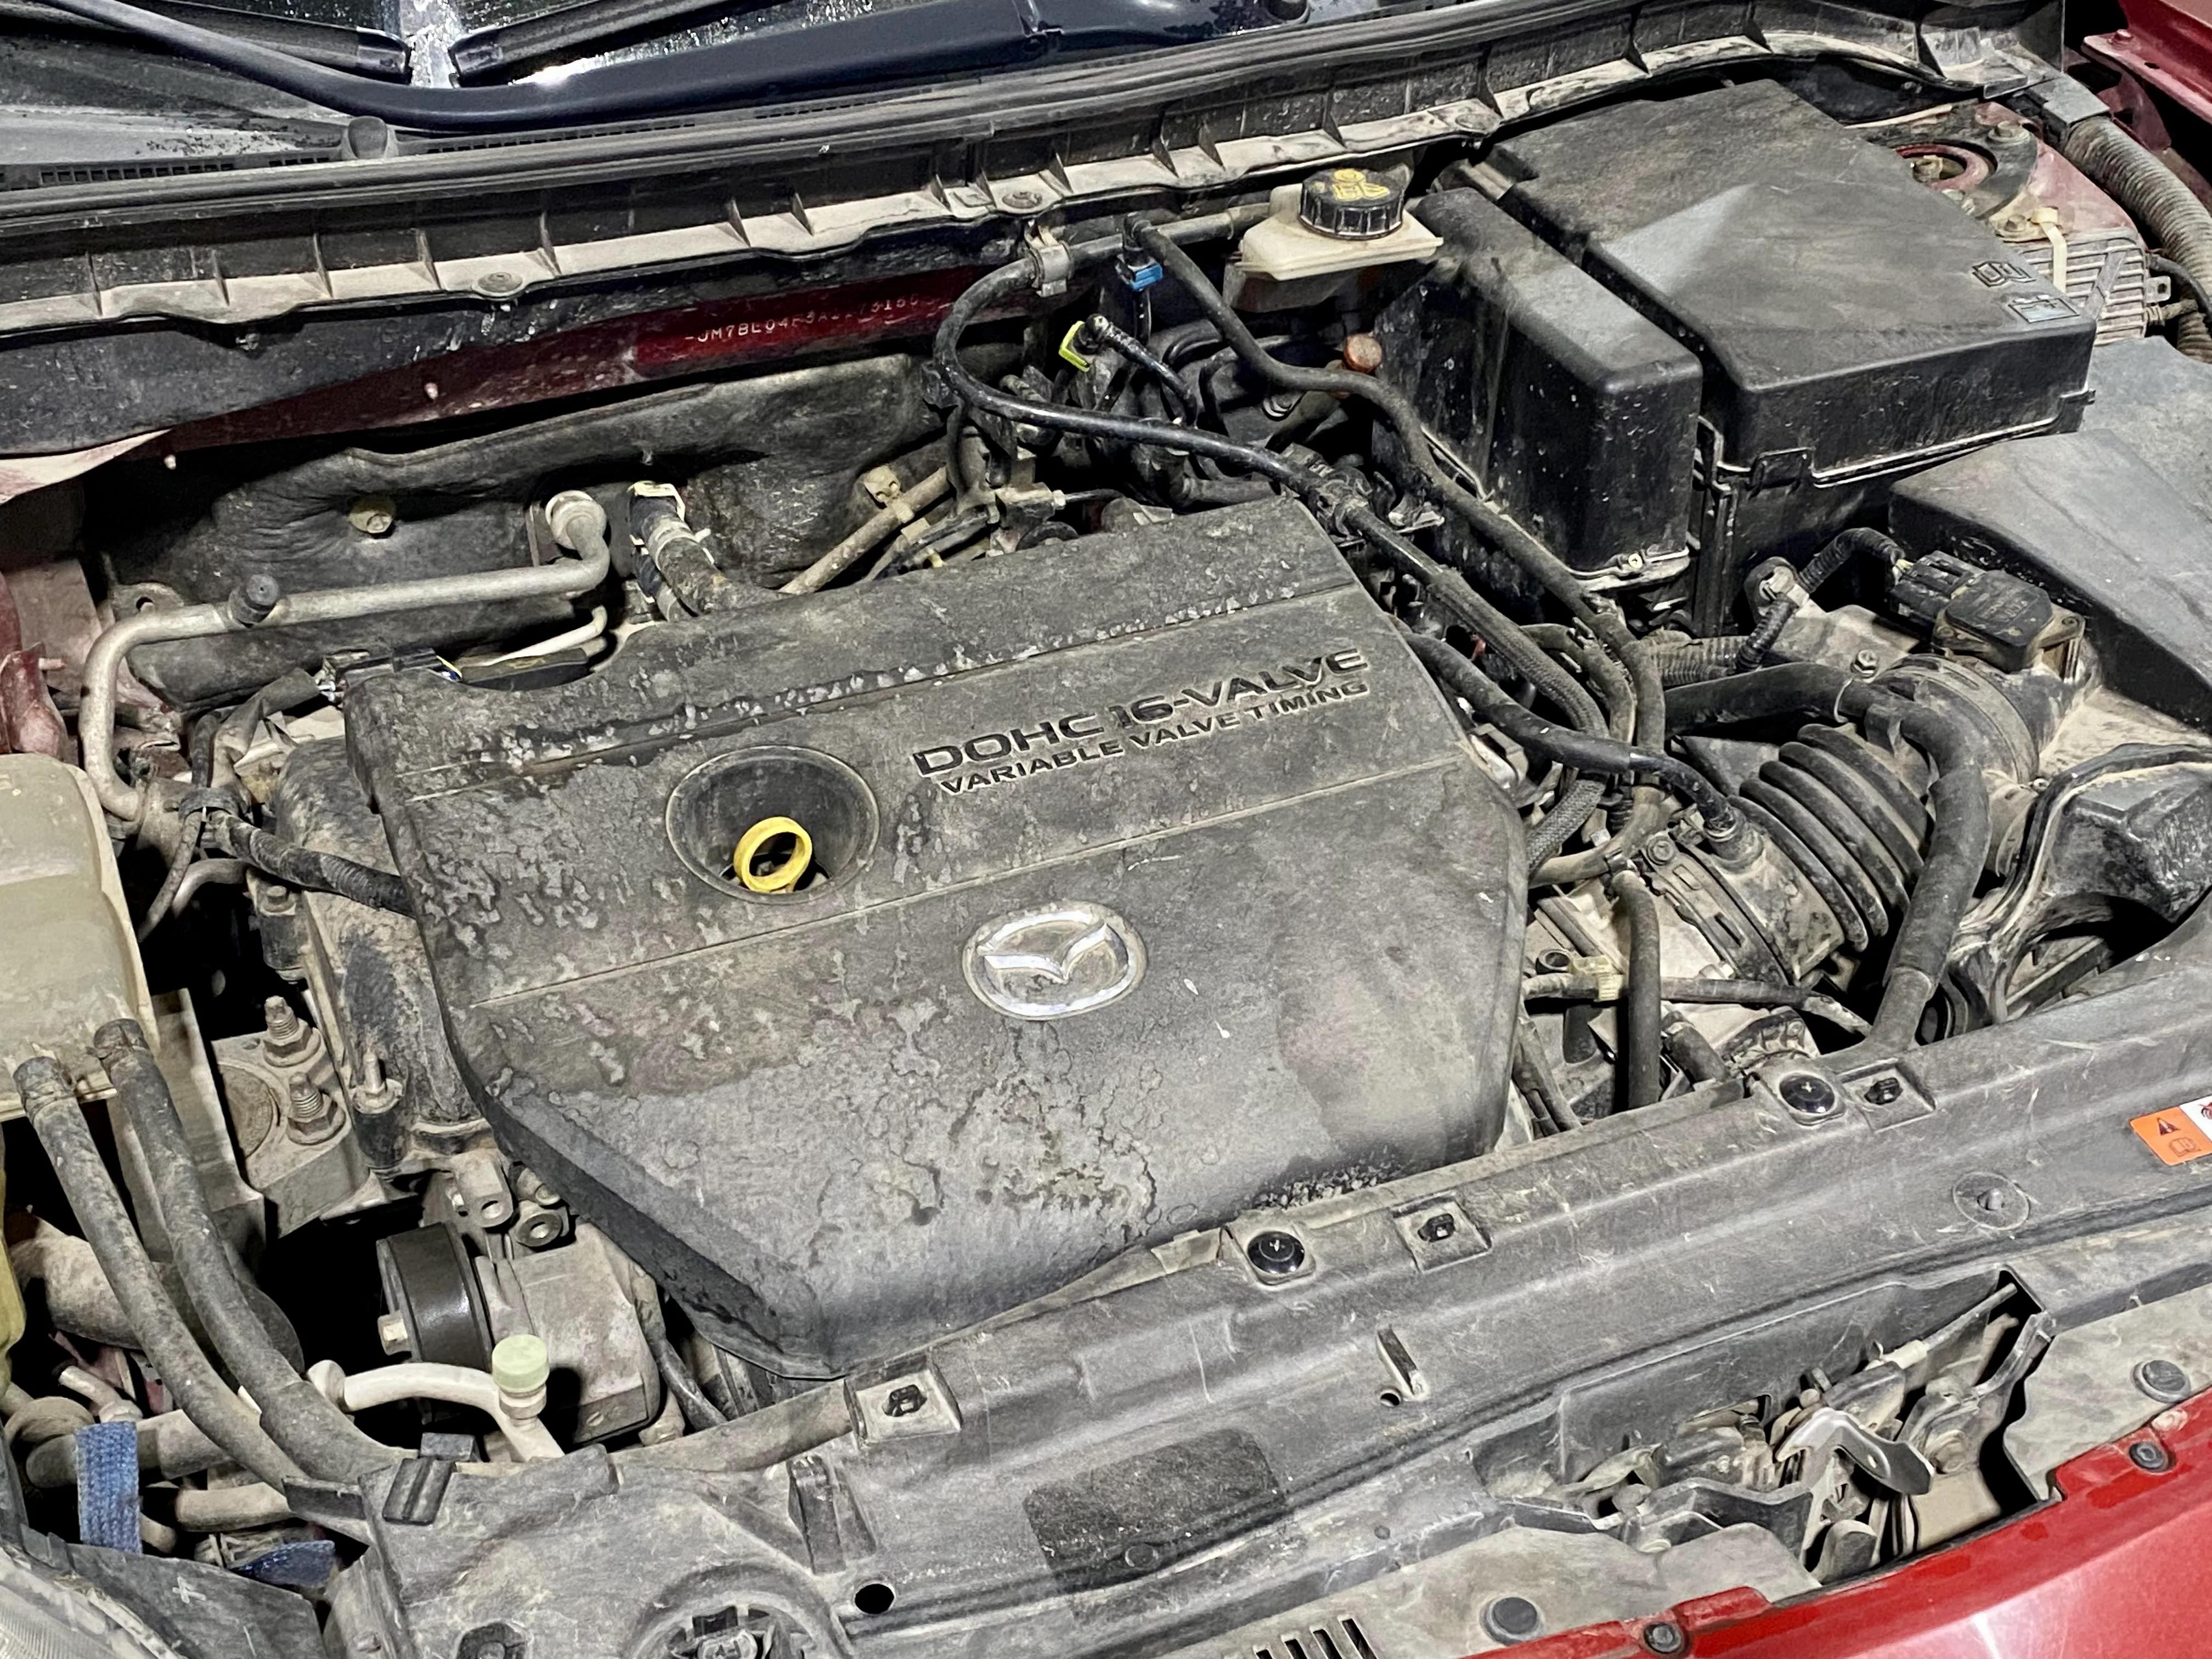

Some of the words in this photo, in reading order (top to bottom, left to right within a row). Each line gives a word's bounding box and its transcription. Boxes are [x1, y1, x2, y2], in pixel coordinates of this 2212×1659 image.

[912, 712, 1105, 776] DOHC
[1108, 647, 1369, 729] 16-VALVE
[940, 739, 1125, 794] VARIABLE
[1128, 711, 1241, 748] VALVE
[1243, 680, 1369, 720] TIMING
